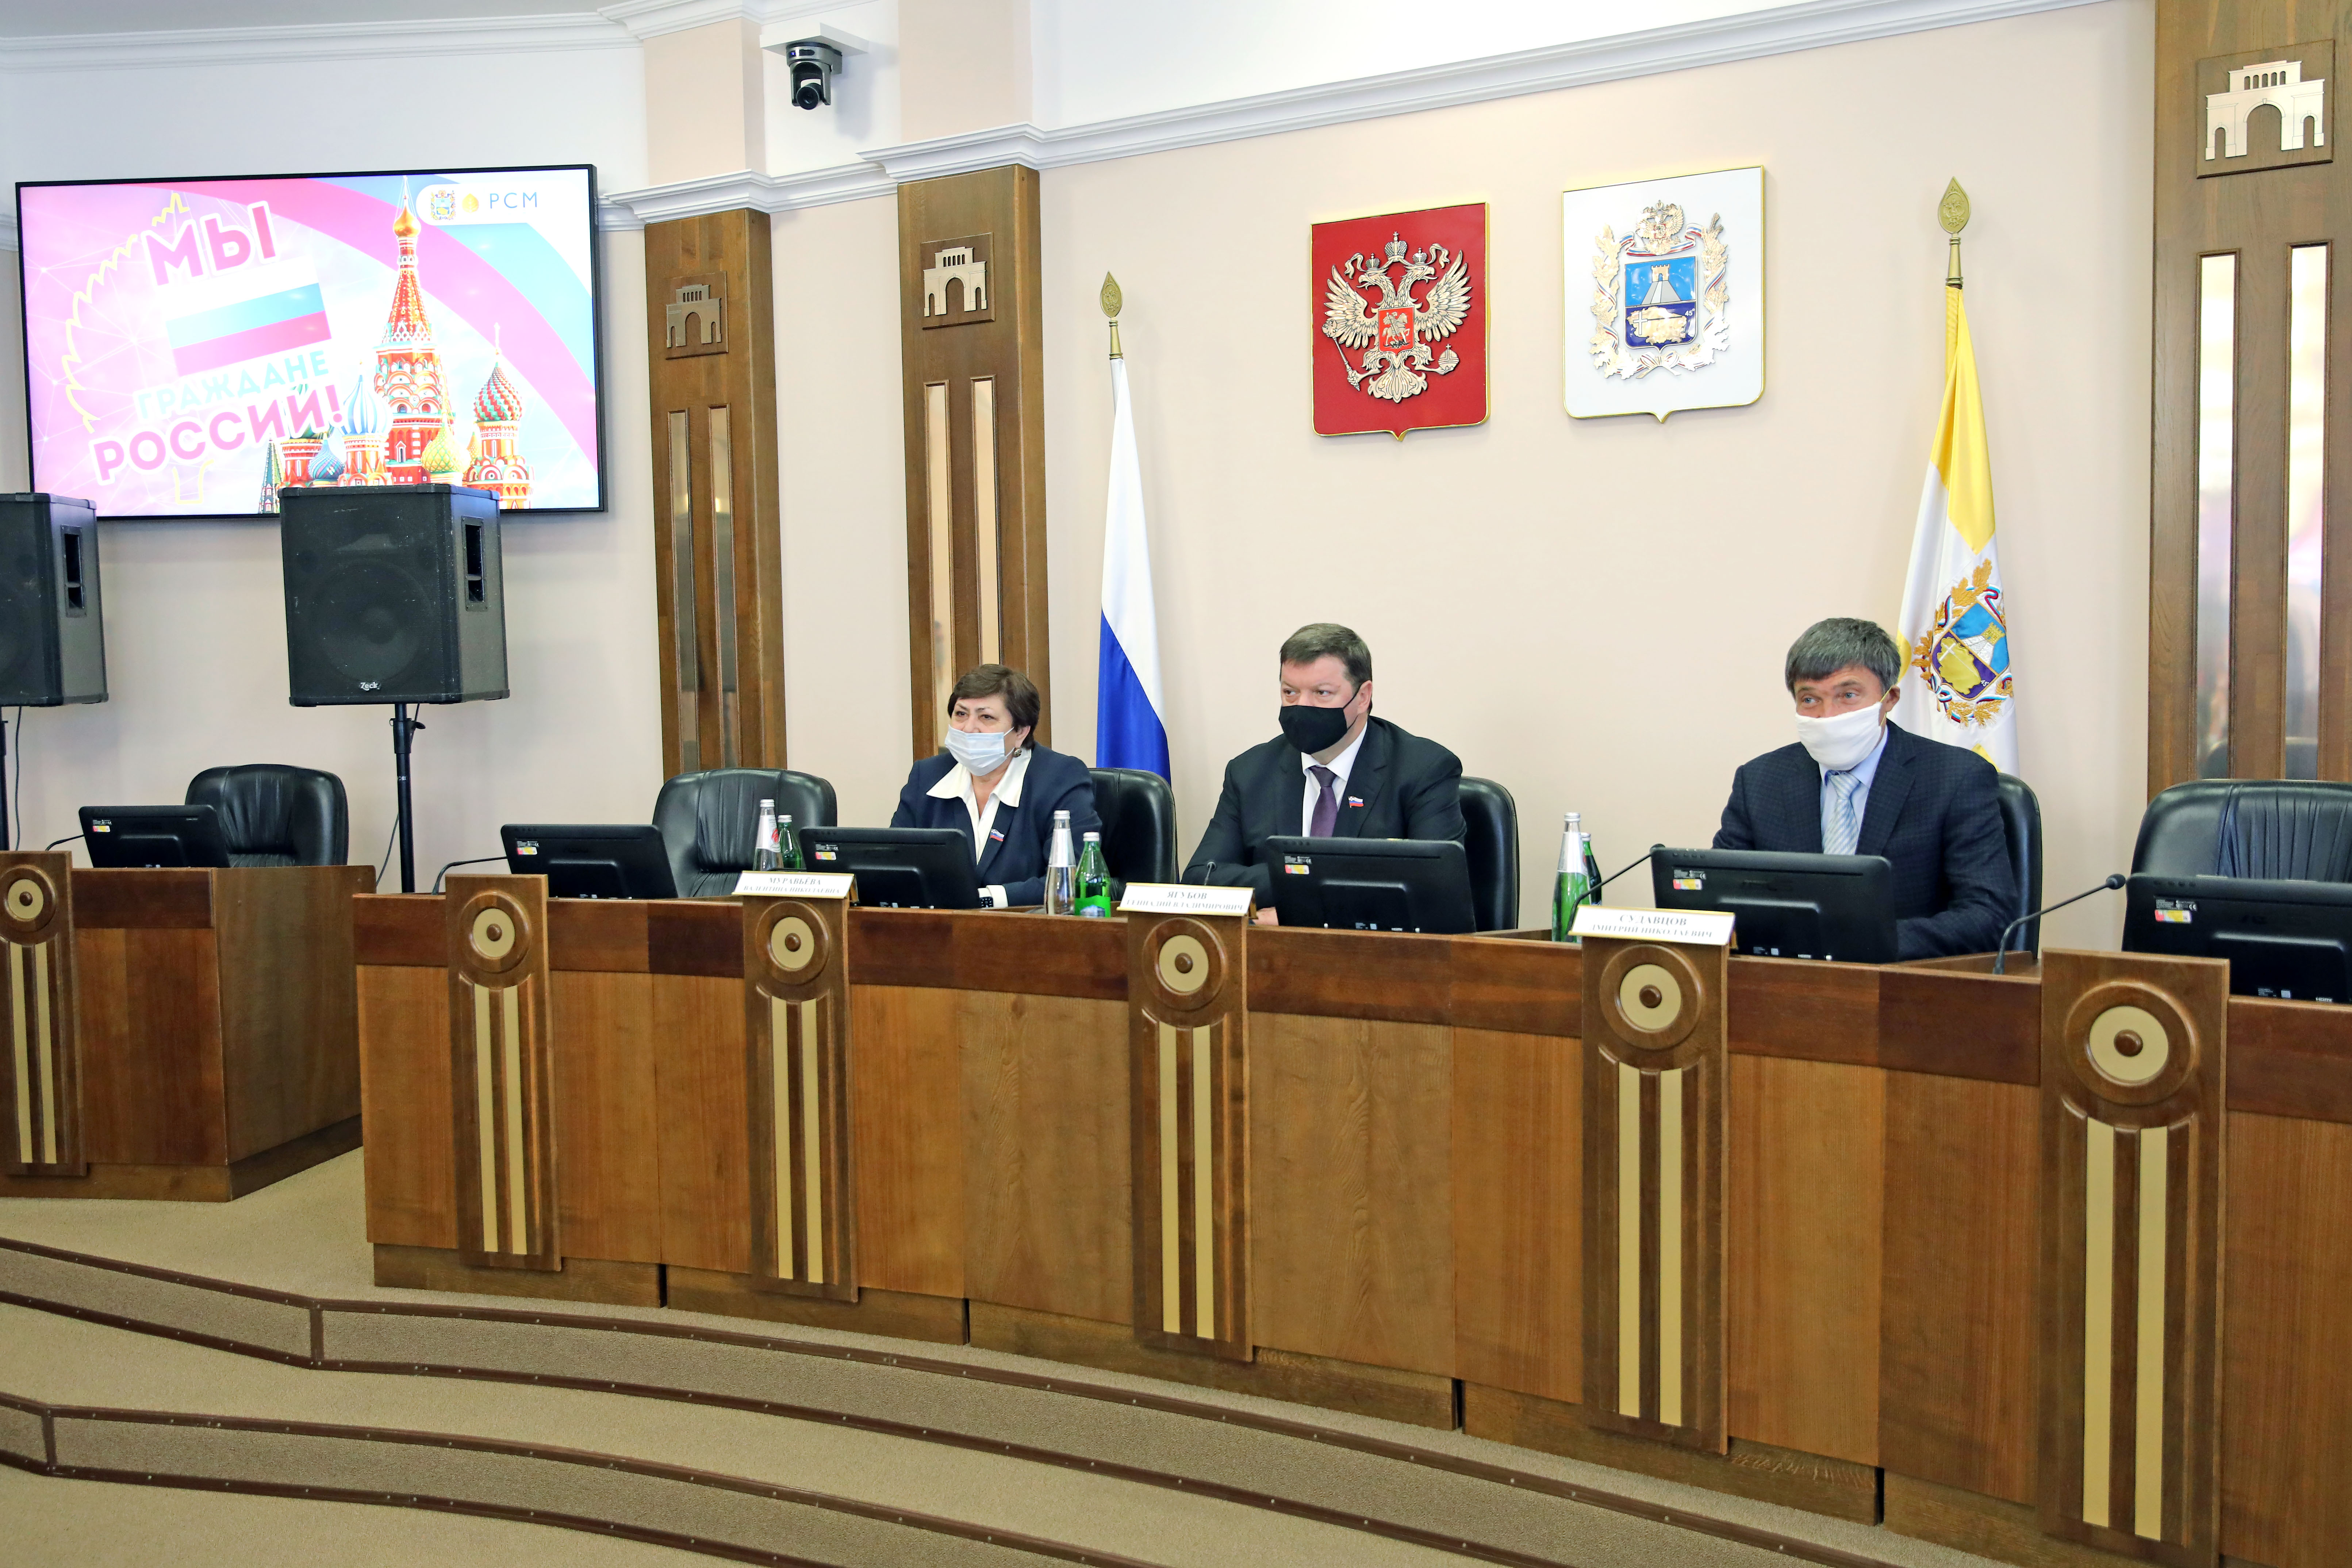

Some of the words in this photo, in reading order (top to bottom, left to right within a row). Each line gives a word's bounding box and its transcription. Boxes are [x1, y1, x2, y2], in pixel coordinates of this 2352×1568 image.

[490, 192, 537, 209] РСМ
[145, 205, 276, 286] МЫ
[137, 349, 329, 419] ГРАЖДАНЕ
[93, 384, 343, 482] РОССИИ!
[769, 877, 821, 885] МУРАВЬЁВА
[1167, 891, 1208, 900] ЯГУБОВ
[1619, 914, 1687, 926] СУДАВЦОВ
